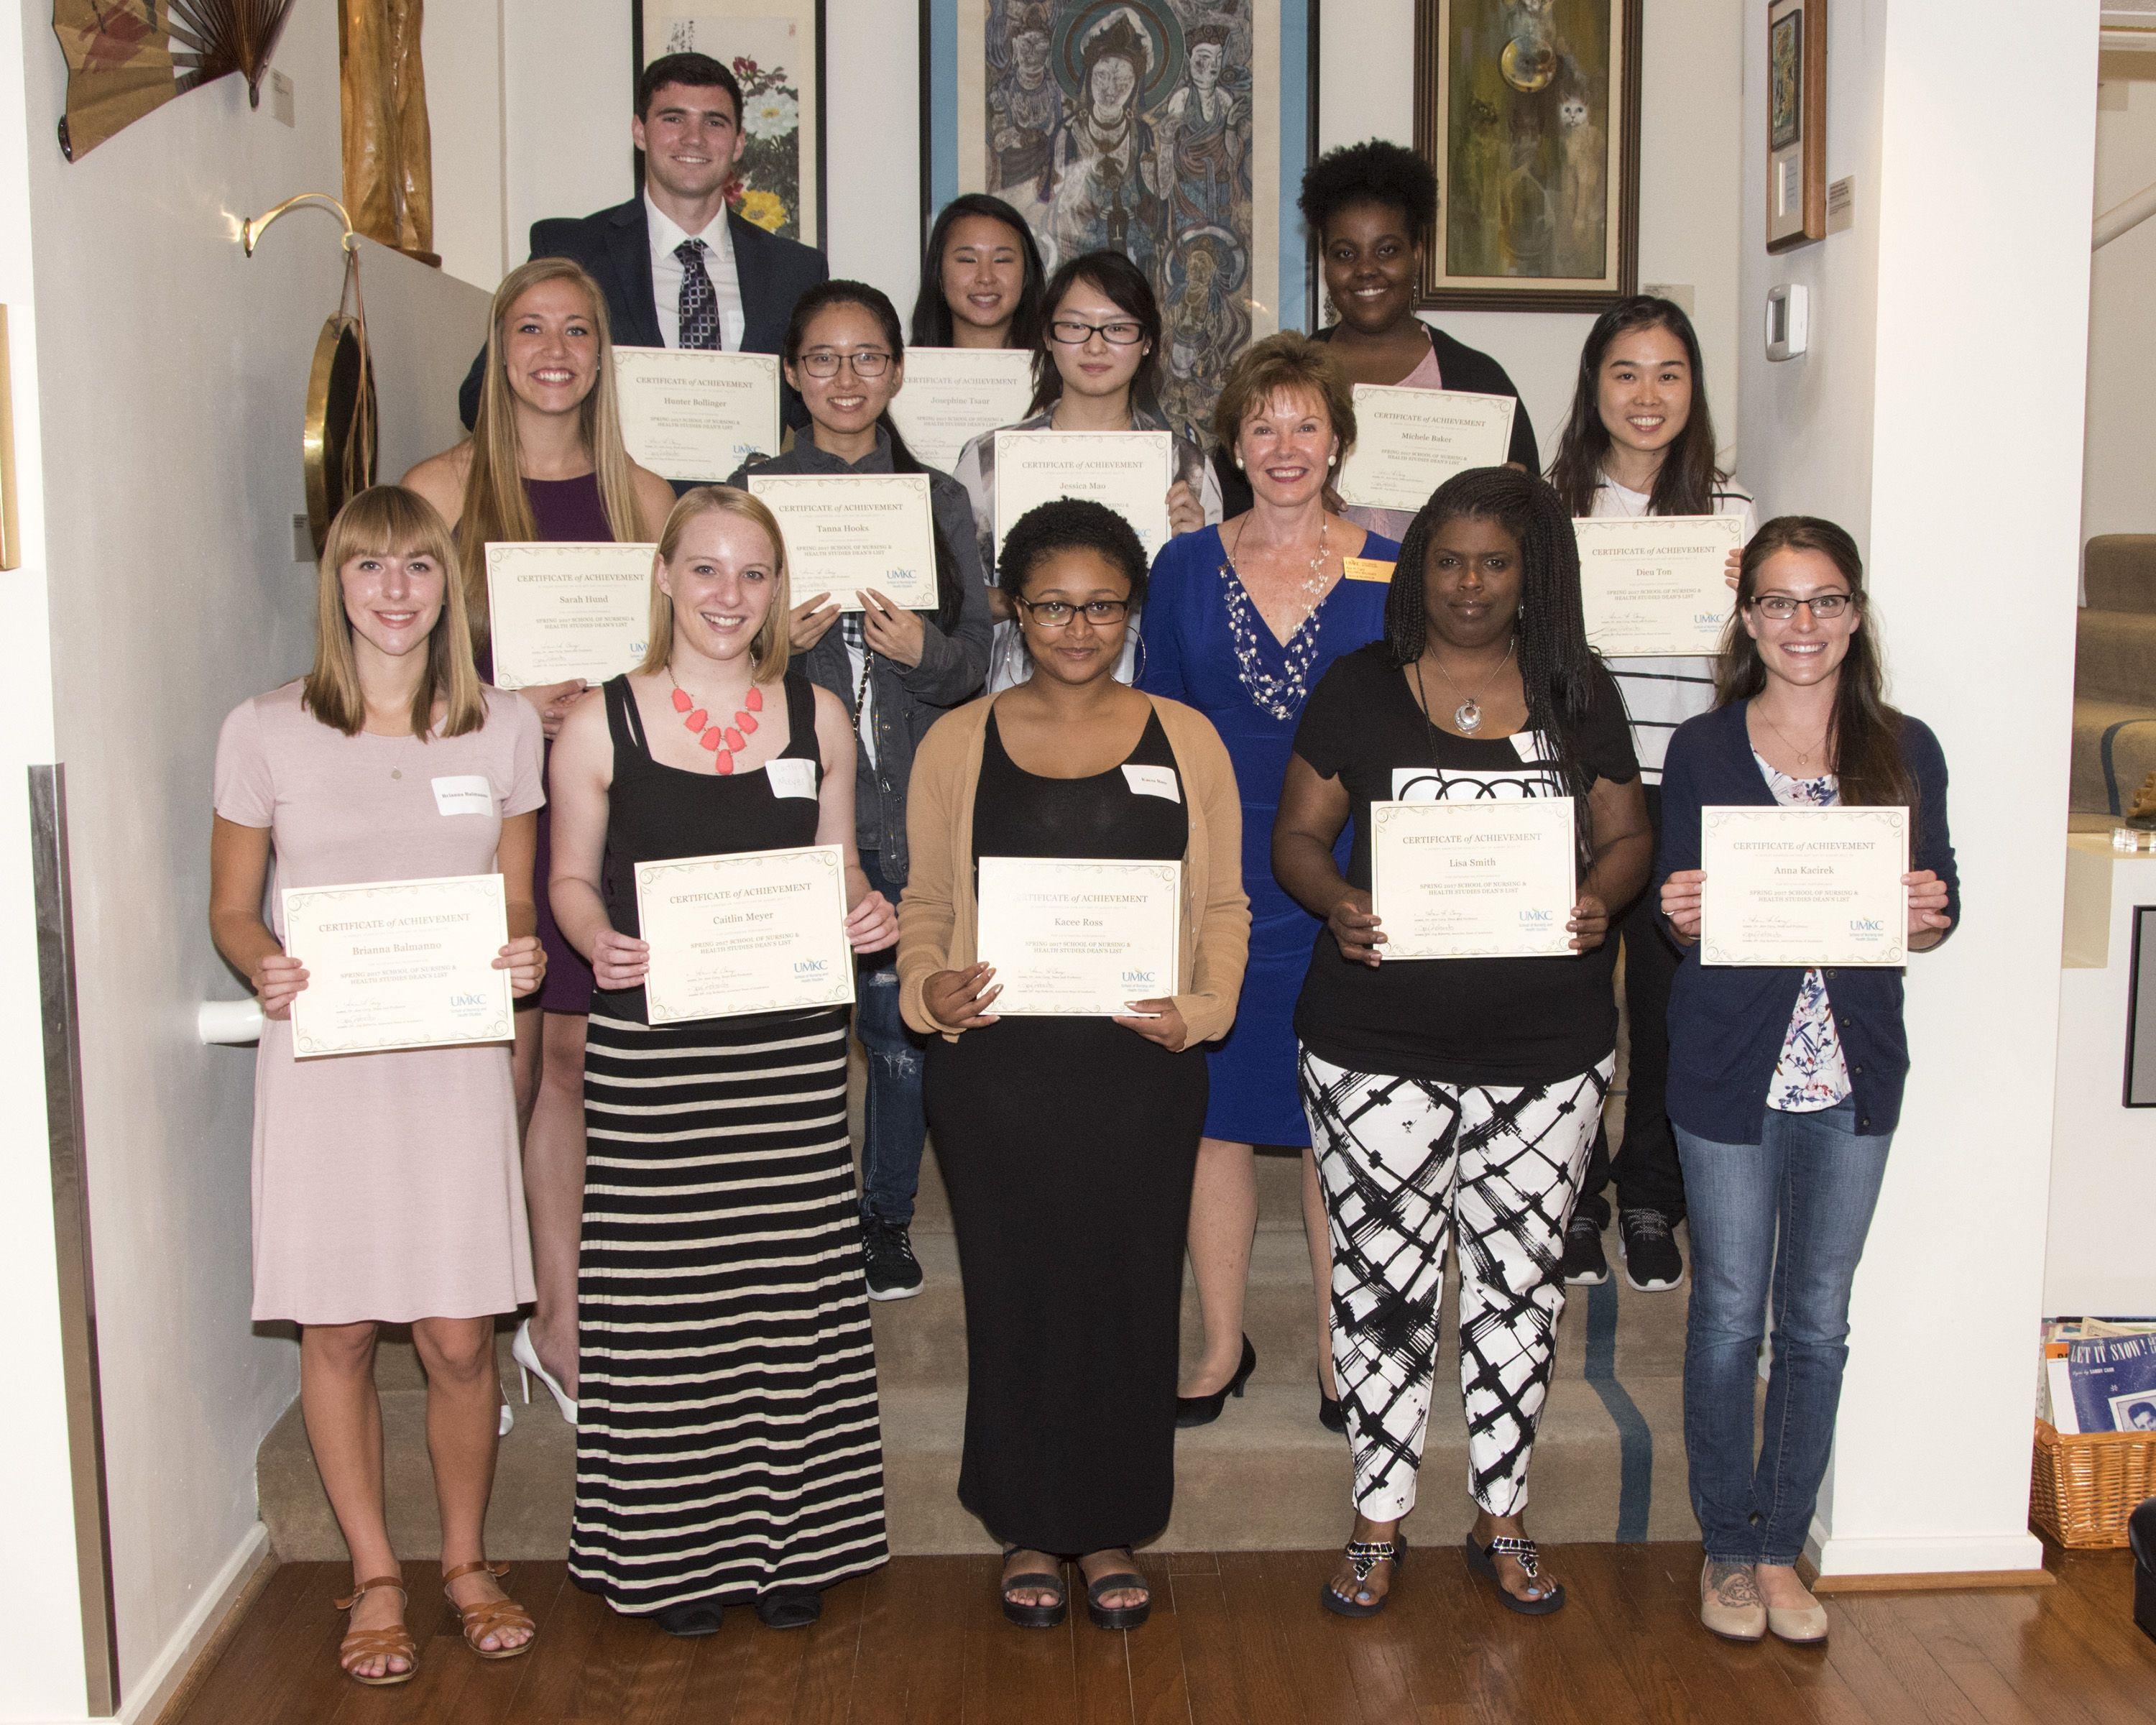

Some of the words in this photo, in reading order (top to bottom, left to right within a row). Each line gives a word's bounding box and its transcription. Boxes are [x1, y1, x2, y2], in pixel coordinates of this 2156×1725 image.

[636, 377, 686, 385] CERTIFICATE
[697, 380, 753, 388] ACHIEVEMENT
[694, 399, 727, 408] Bollinger
[1374, 412, 1422, 421] CERTIFICATE
[1431, 416, 1486, 427] ACHIEVEMENT
[1647, 547, 1654, 556] of
[575, 574, 584, 582] of
[887, 569, 916, 579] UMKC
[1695, 613, 1723, 622] UMKC
[630, 643, 648, 652] UM
[1402, 835, 1462, 844] CERTIFICATE
[1465, 834, 1473, 844] of
[1475, 833, 1542, 842] ACHIEVEMENT
[1797, 842, 1805, 851] of
[1450, 859, 1467, 868] Lisa
[1470, 858, 1496, 867] Smith
[669, 891, 731, 904] CERTIFICATE
[732, 889, 742, 899] of
[743, 883, 812, 897] ACHIEVEMENT
[1072, 894, 1081, 903] of
[713, 914, 743, 925] Caitlin
[746, 911, 773, 923] Meyer
[1519, 909, 1552, 921] UMKC
[318, 919, 384, 932] CERTIFICATE
[386, 919, 396, 929] of
[397, 914, 470, 926] ACHIEVEMENT
[1851, 920, 1884, 931] UMKC
[353, 945, 390, 955] Brianna
[394, 942, 441, 953] Balmanno
[793, 960, 827, 973] UMKC
[1123, 971, 1155, 981] UMKC
[450, 993, 486, 1006] UMKC
[2070, 1345, 2091, 1363] LET
[2093, 1345, 2106, 1363] IT
